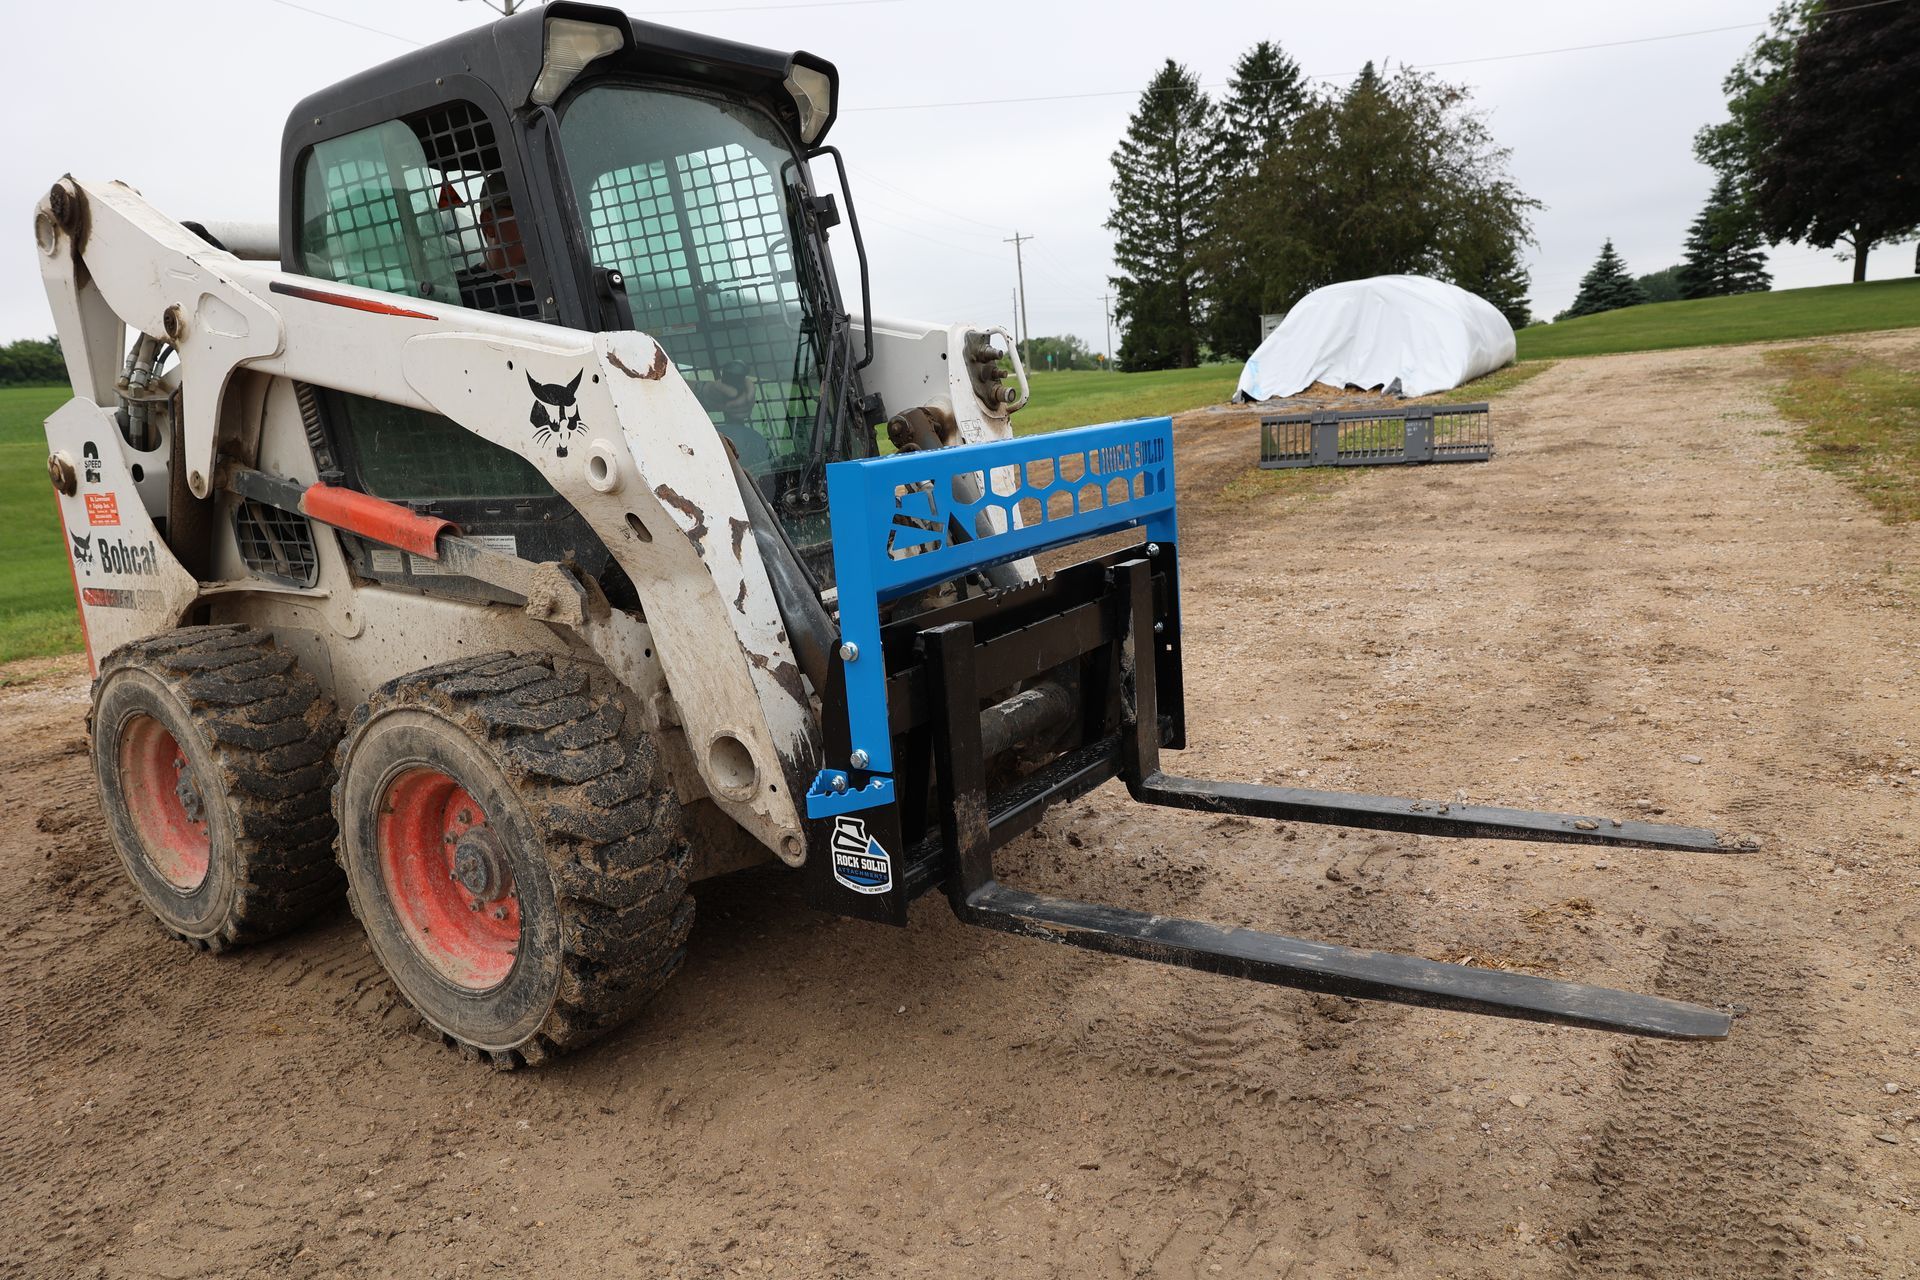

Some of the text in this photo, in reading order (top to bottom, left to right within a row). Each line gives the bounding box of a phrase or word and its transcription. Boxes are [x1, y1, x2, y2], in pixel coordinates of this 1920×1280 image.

[84, 460, 102, 469] SPEED
[97, 538, 160, 577] Bobcat
[836, 854, 887, 873] ROCK SOLID
[837, 867, 888, 880] ATTACHMENTS
